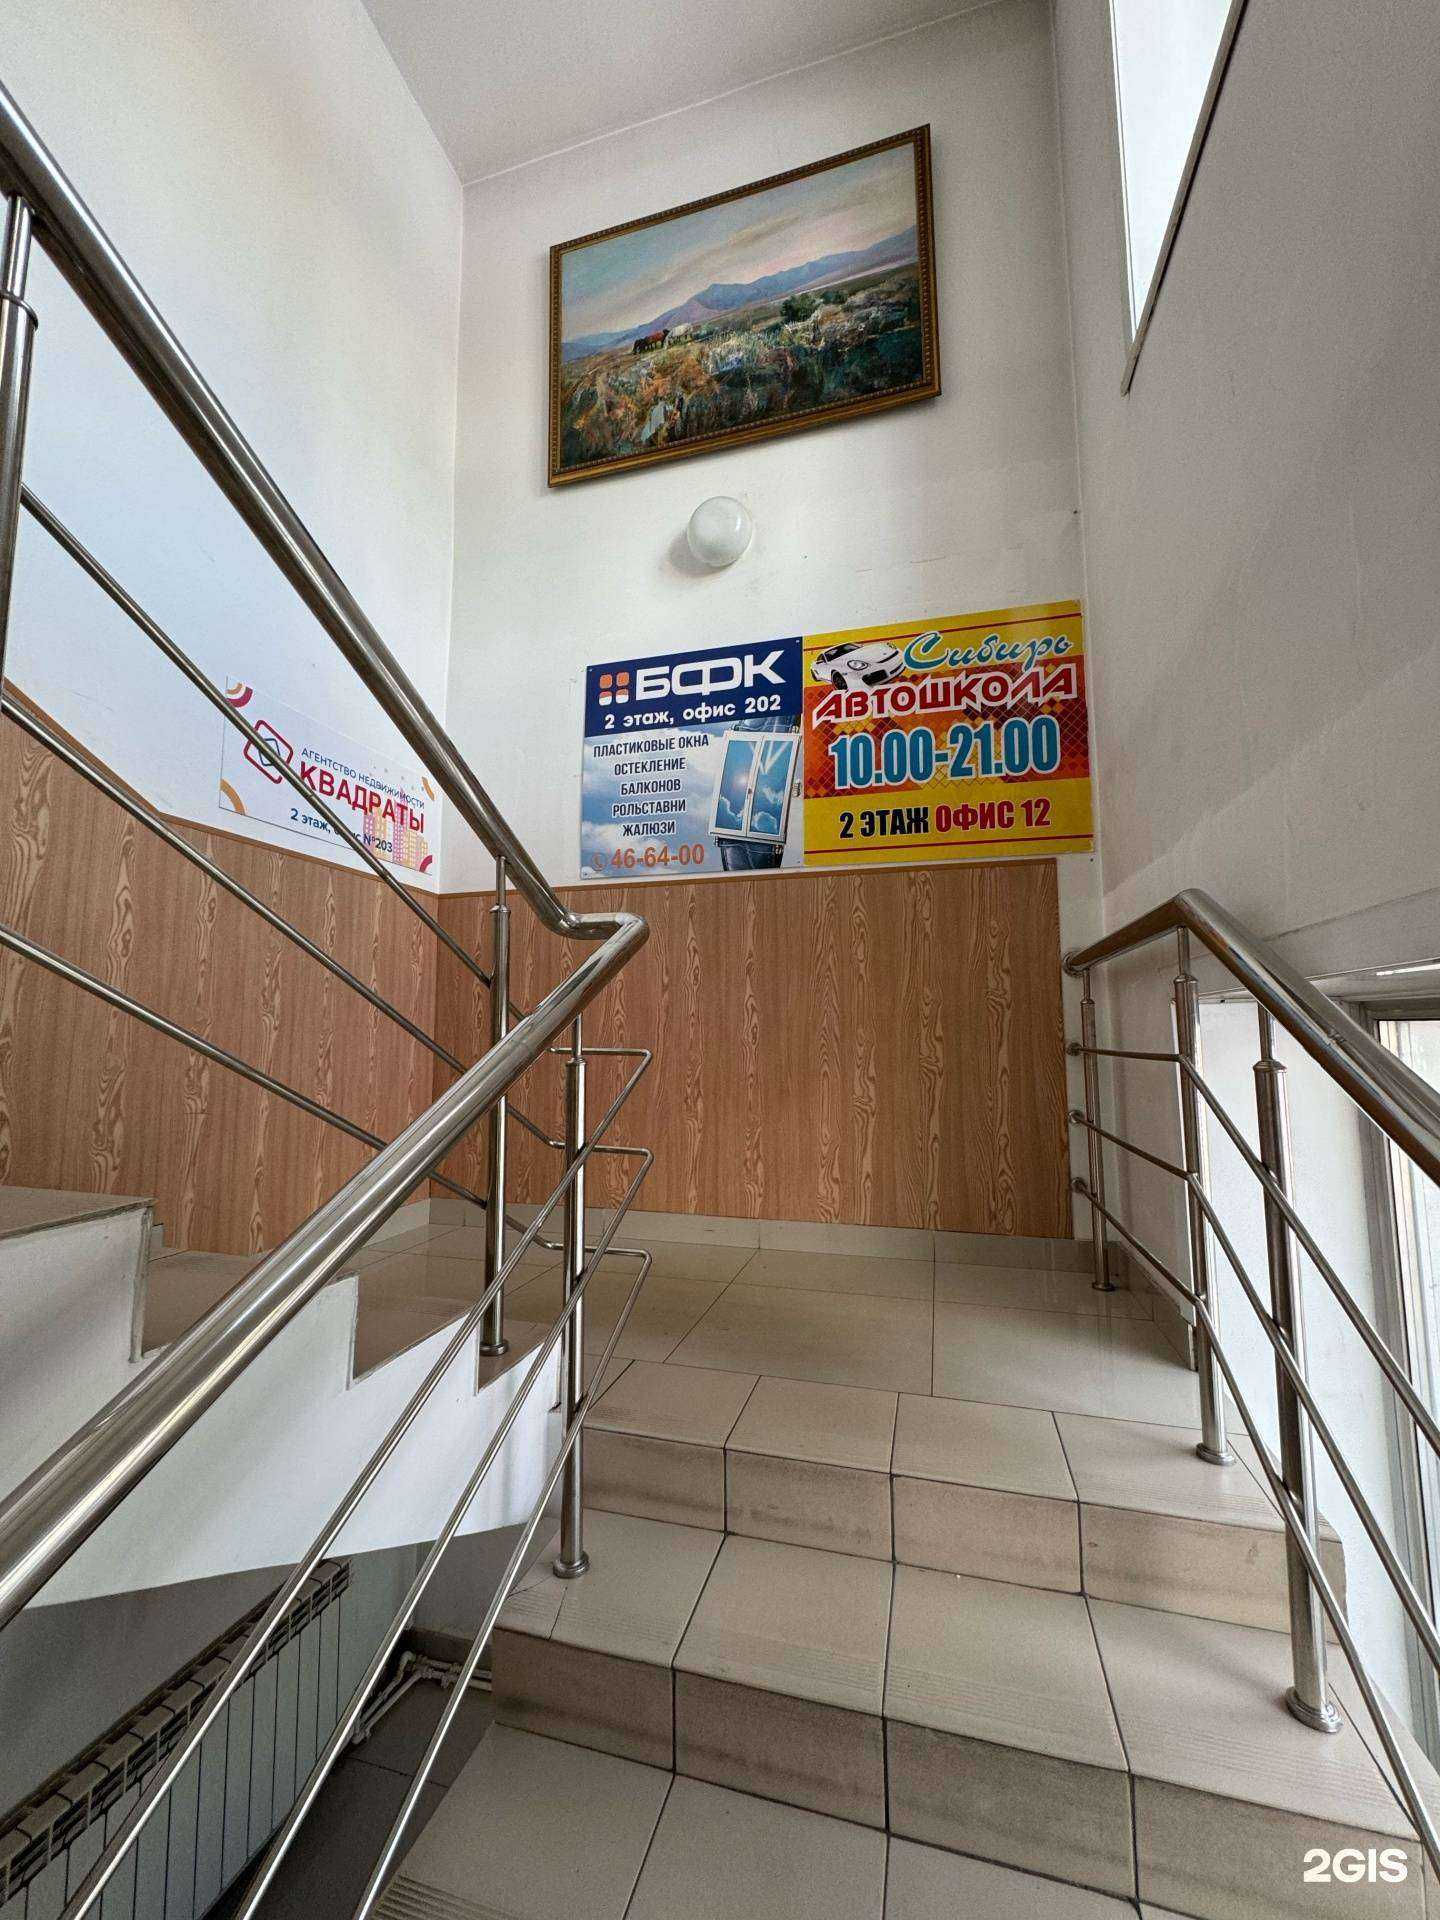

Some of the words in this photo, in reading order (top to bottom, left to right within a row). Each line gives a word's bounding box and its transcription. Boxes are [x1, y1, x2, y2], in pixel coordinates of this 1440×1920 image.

[904, 632, 1072, 672] Сибирь
[635, 650, 786, 701] БФК
[604, 714, 615, 730] 2
[623, 711, 674, 728] этаж,
[682, 702, 736, 723] офис
[744, 694, 781, 714] 202
[813, 664, 1078, 728] АВТОШКОЛА
[593, 737, 675, 758] ПЛАСТИКОВЫЕ
[678, 734, 709, 749] ОКНА
[830, 715, 1061, 789] 10.00-21.00
[301, 748, 357, 779] АГЕНТСТВО
[358, 774, 425, 809] НЕДВИЖИМОСТИ
[614, 757, 686, 776] ОСТЕКЛЕНИЕ
[300, 760, 425, 834] КВАДРАТЫ
[621, 778, 681, 796] БАЛКОНОВ
[290, 808, 299, 821] 2
[301, 815, 331, 834] этаж,
[612, 799, 686, 818] РОЛЬСТАВНИ
[839, 812, 854, 839] 2
[860, 806, 929, 837] ЭТАЖ
[935, 800, 1014, 833] ОФИС
[1021, 798, 1051, 827] 12
[622, 821, 675, 837] ЖАЛЮЗИ
[611, 844, 705, 870] 46-64-00
